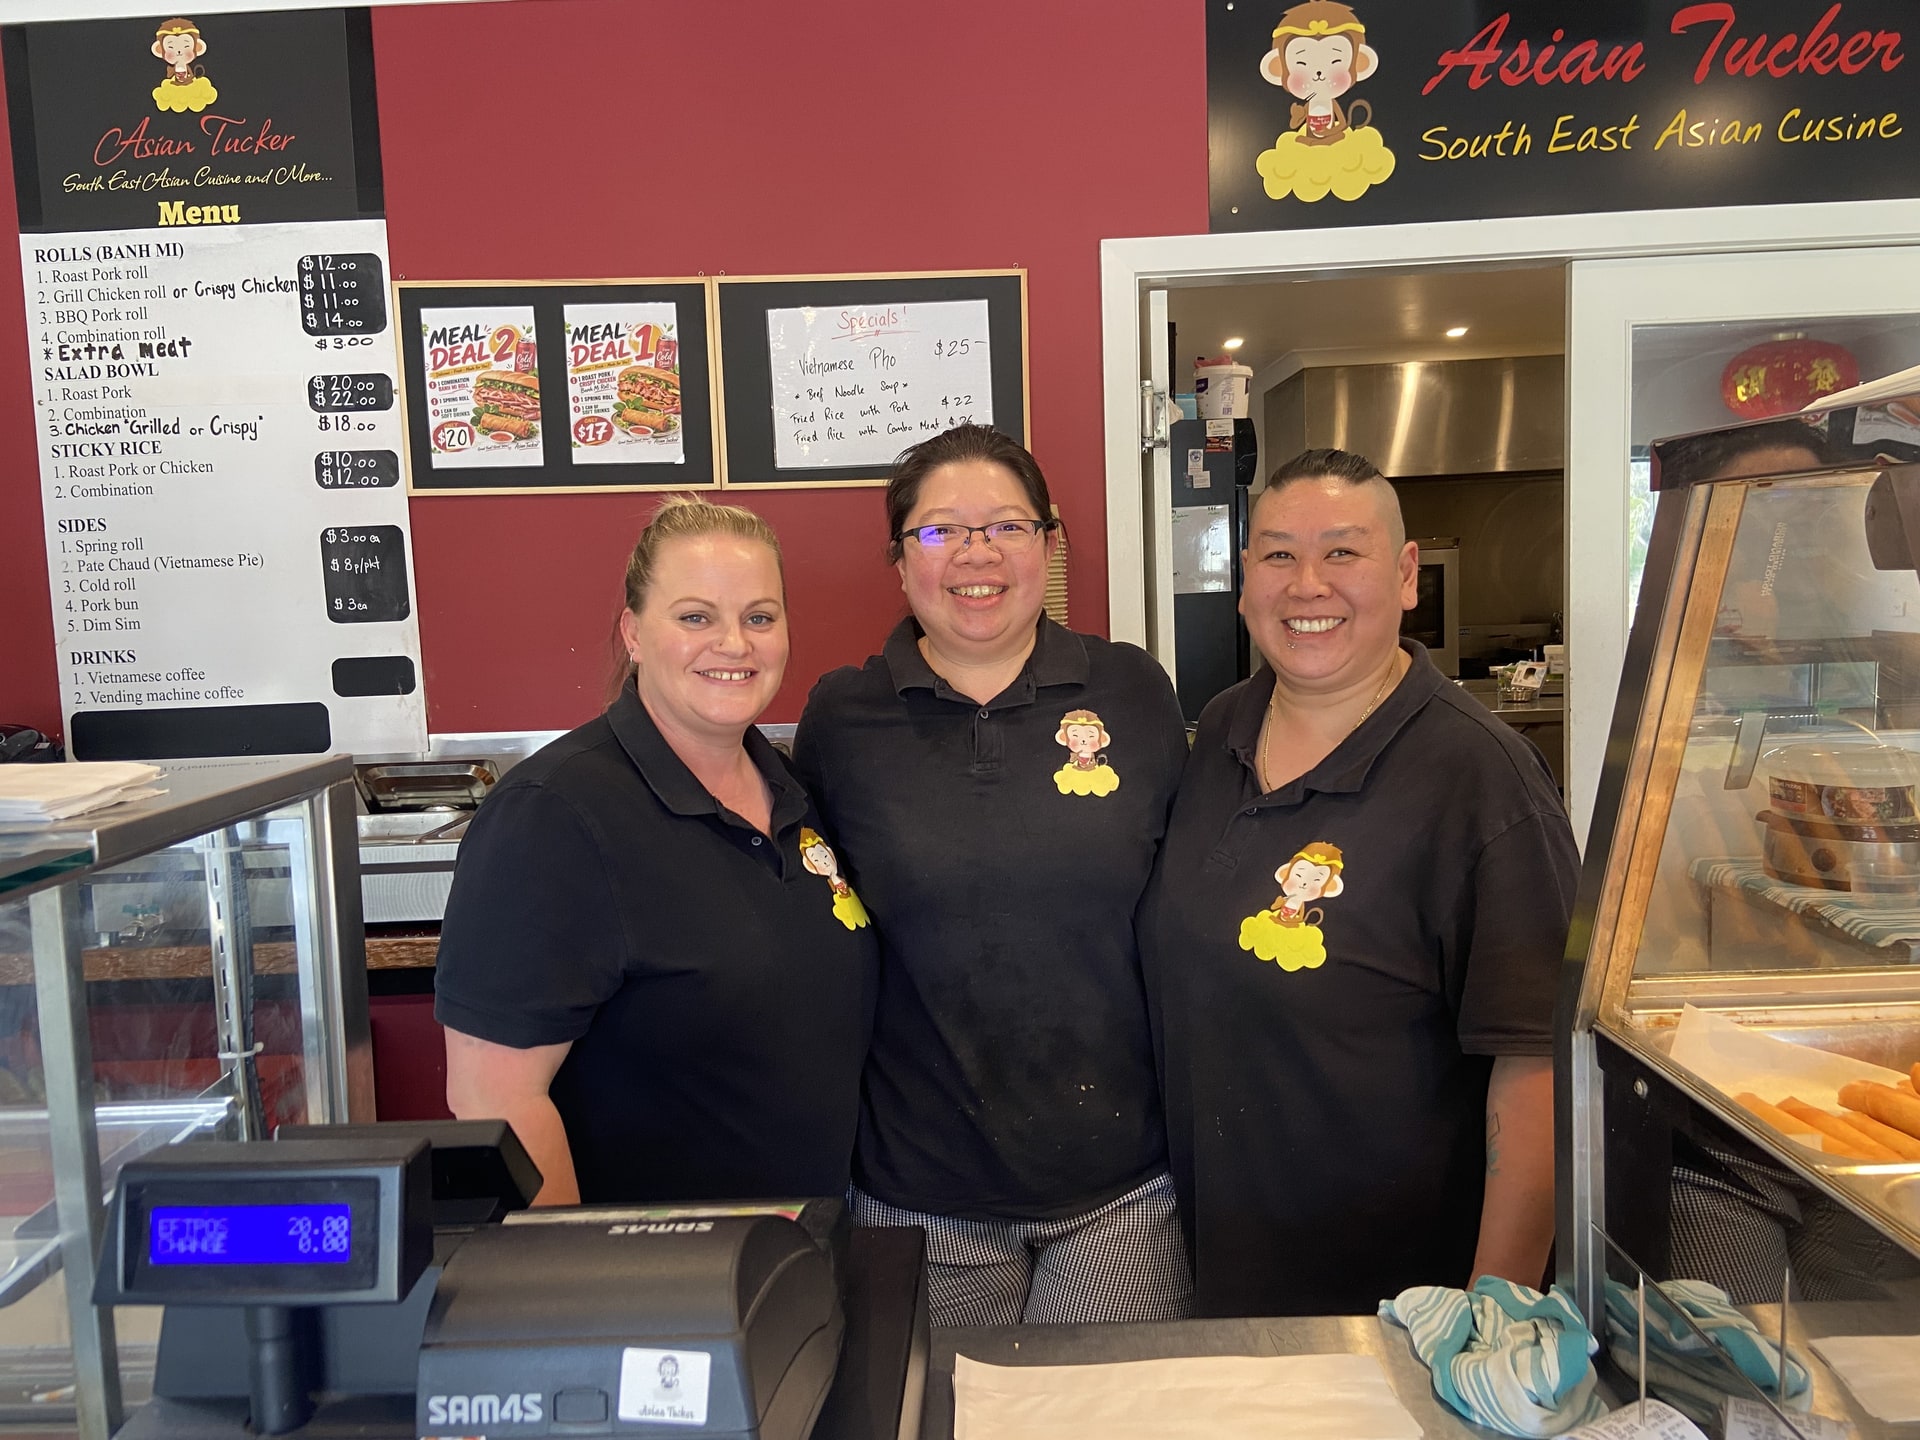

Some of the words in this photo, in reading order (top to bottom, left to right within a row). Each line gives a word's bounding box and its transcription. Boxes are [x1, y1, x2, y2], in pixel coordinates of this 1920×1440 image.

[1421, 12, 1646, 96] Asian
[1670, 2, 1904, 85] Tucker
[93, 116, 196, 167] Asian
[200, 115, 296, 156] Tucker
[1418, 120, 1531, 161] South
[1547, 113, 1640, 154] East
[1653, 108, 1762, 151] Asian
[1777, 107, 1903, 143] Cusine
[63, 172, 105, 193] South
[107, 169, 141, 191] East
[142, 167, 191, 192] Asian
[193, 165, 241, 188] Cuisine
[245, 168, 273, 184] and
[274, 162, 333, 183] More...
[158, 200, 241, 226] Menu
[34, 246, 92, 263] ROLLS
[96, 243, 150, 263] (BANH
[156, 242, 184, 260] MI)
[37, 270, 48, 284] 1.
[52, 269, 89, 283] Roast
[92, 267, 122, 281] Pork
[126, 266, 148, 280] roll
[38, 291, 50, 304] 2.
[53, 289, 83, 303] Grill
[87, 287, 141, 302] Chicken
[144, 285, 167, 299] roll
[173, 287, 188, 299] or
[194, 280, 236, 300] Crispy
[242, 276, 299, 294] Chicken
[39, 311, 52, 324] 3.
[55, 309, 88, 326] BBQ
[92, 308, 122, 322] Pork
[126, 306, 148, 320] roll
[41, 331, 53, 344] 4.
[57, 327, 140, 344] Combination
[144, 326, 166, 340] roll
[429, 324, 486, 349] MEAL
[571, 322, 627, 346] MEAL
[58, 342, 125, 362] Extra
[429, 341, 490, 371] DEAL
[494, 328, 515, 363] 2
[570, 340, 631, 367] DEAL
[635, 324, 654, 362] 1
[656, 350, 673, 364] Cold
[798, 354, 855, 377] Vietnamese
[869, 346, 896, 371] Pho
[44, 365, 102, 382] SALAD
[107, 362, 159, 379] BOWL
[581, 373, 597, 381] ROAST
[598, 371, 611, 379] PORK
[47, 388, 58, 402] 1.
[62, 387, 98, 401] Roast
[102, 385, 132, 399] Pork
[807, 388, 824, 403] Beef
[835, 384, 865, 398] Noodle
[48, 409, 60, 422] 2.
[63, 405, 147, 421] Combination
[790, 411, 815, 426] Fried
[824, 407, 845, 421] Rice
[859, 404, 880, 419] with
[889, 399, 910, 414] Pork
[50, 425, 62, 437] 3.
[65, 422, 120, 436] Chicken
[190, 425, 204, 436] or
[578, 421, 608, 442] $17
[793, 430, 819, 445] Fried
[827, 426, 845, 441] Rice
[858, 423, 878, 437] with
[886, 422, 913, 436] Combo
[919, 420, 940, 432] Meat
[51, 441, 115, 459] STICKY
[120, 440, 163, 455] RICE
[54, 466, 65, 479] 1.
[69, 464, 105, 478] Roast
[109, 462, 139, 476] Pork
[143, 464, 157, 475] or
[160, 459, 214, 475] Chicken
[55, 486, 67, 499] 2.
[70, 482, 154, 499] Combination
[58, 517, 107, 533] SIDES
[60, 540, 72, 554] 1.
[75, 539, 118, 556] Spring
[122, 537, 144, 551] roll
[77, 558, 105, 573] Pate
[108, 556, 151, 571] Chaud
[154, 555, 234, 573] (Vietnamese
[238, 552, 265, 568] Pie)
[63, 580, 75, 593] 3.
[79, 578, 110, 592] Cold
[114, 577, 136, 591] roll
[65, 600, 77, 613] 4.
[81, 598, 111, 612] Pork
[114, 597, 139, 611] bun
[67, 619, 79, 633] 5.
[83, 617, 111, 632] Dim
[115, 616, 141, 631] Sim
[70, 649, 137, 665] DRINKS
[74, 672, 84, 685] 1.
[88, 671, 162, 684] Vietnamese
[165, 668, 206, 682] coffee
[74, 692, 86, 705] 2.
[89, 689, 143, 706] Vending
[147, 687, 201, 702] machine
[204, 686, 244, 700] coffee
[157, 1217, 229, 1237] EFTPOS
[287, 1216, 349, 1236] 20.00
[298, 1236, 349, 1253] 0.00
[428, 1392, 543, 1425] SAM4S
